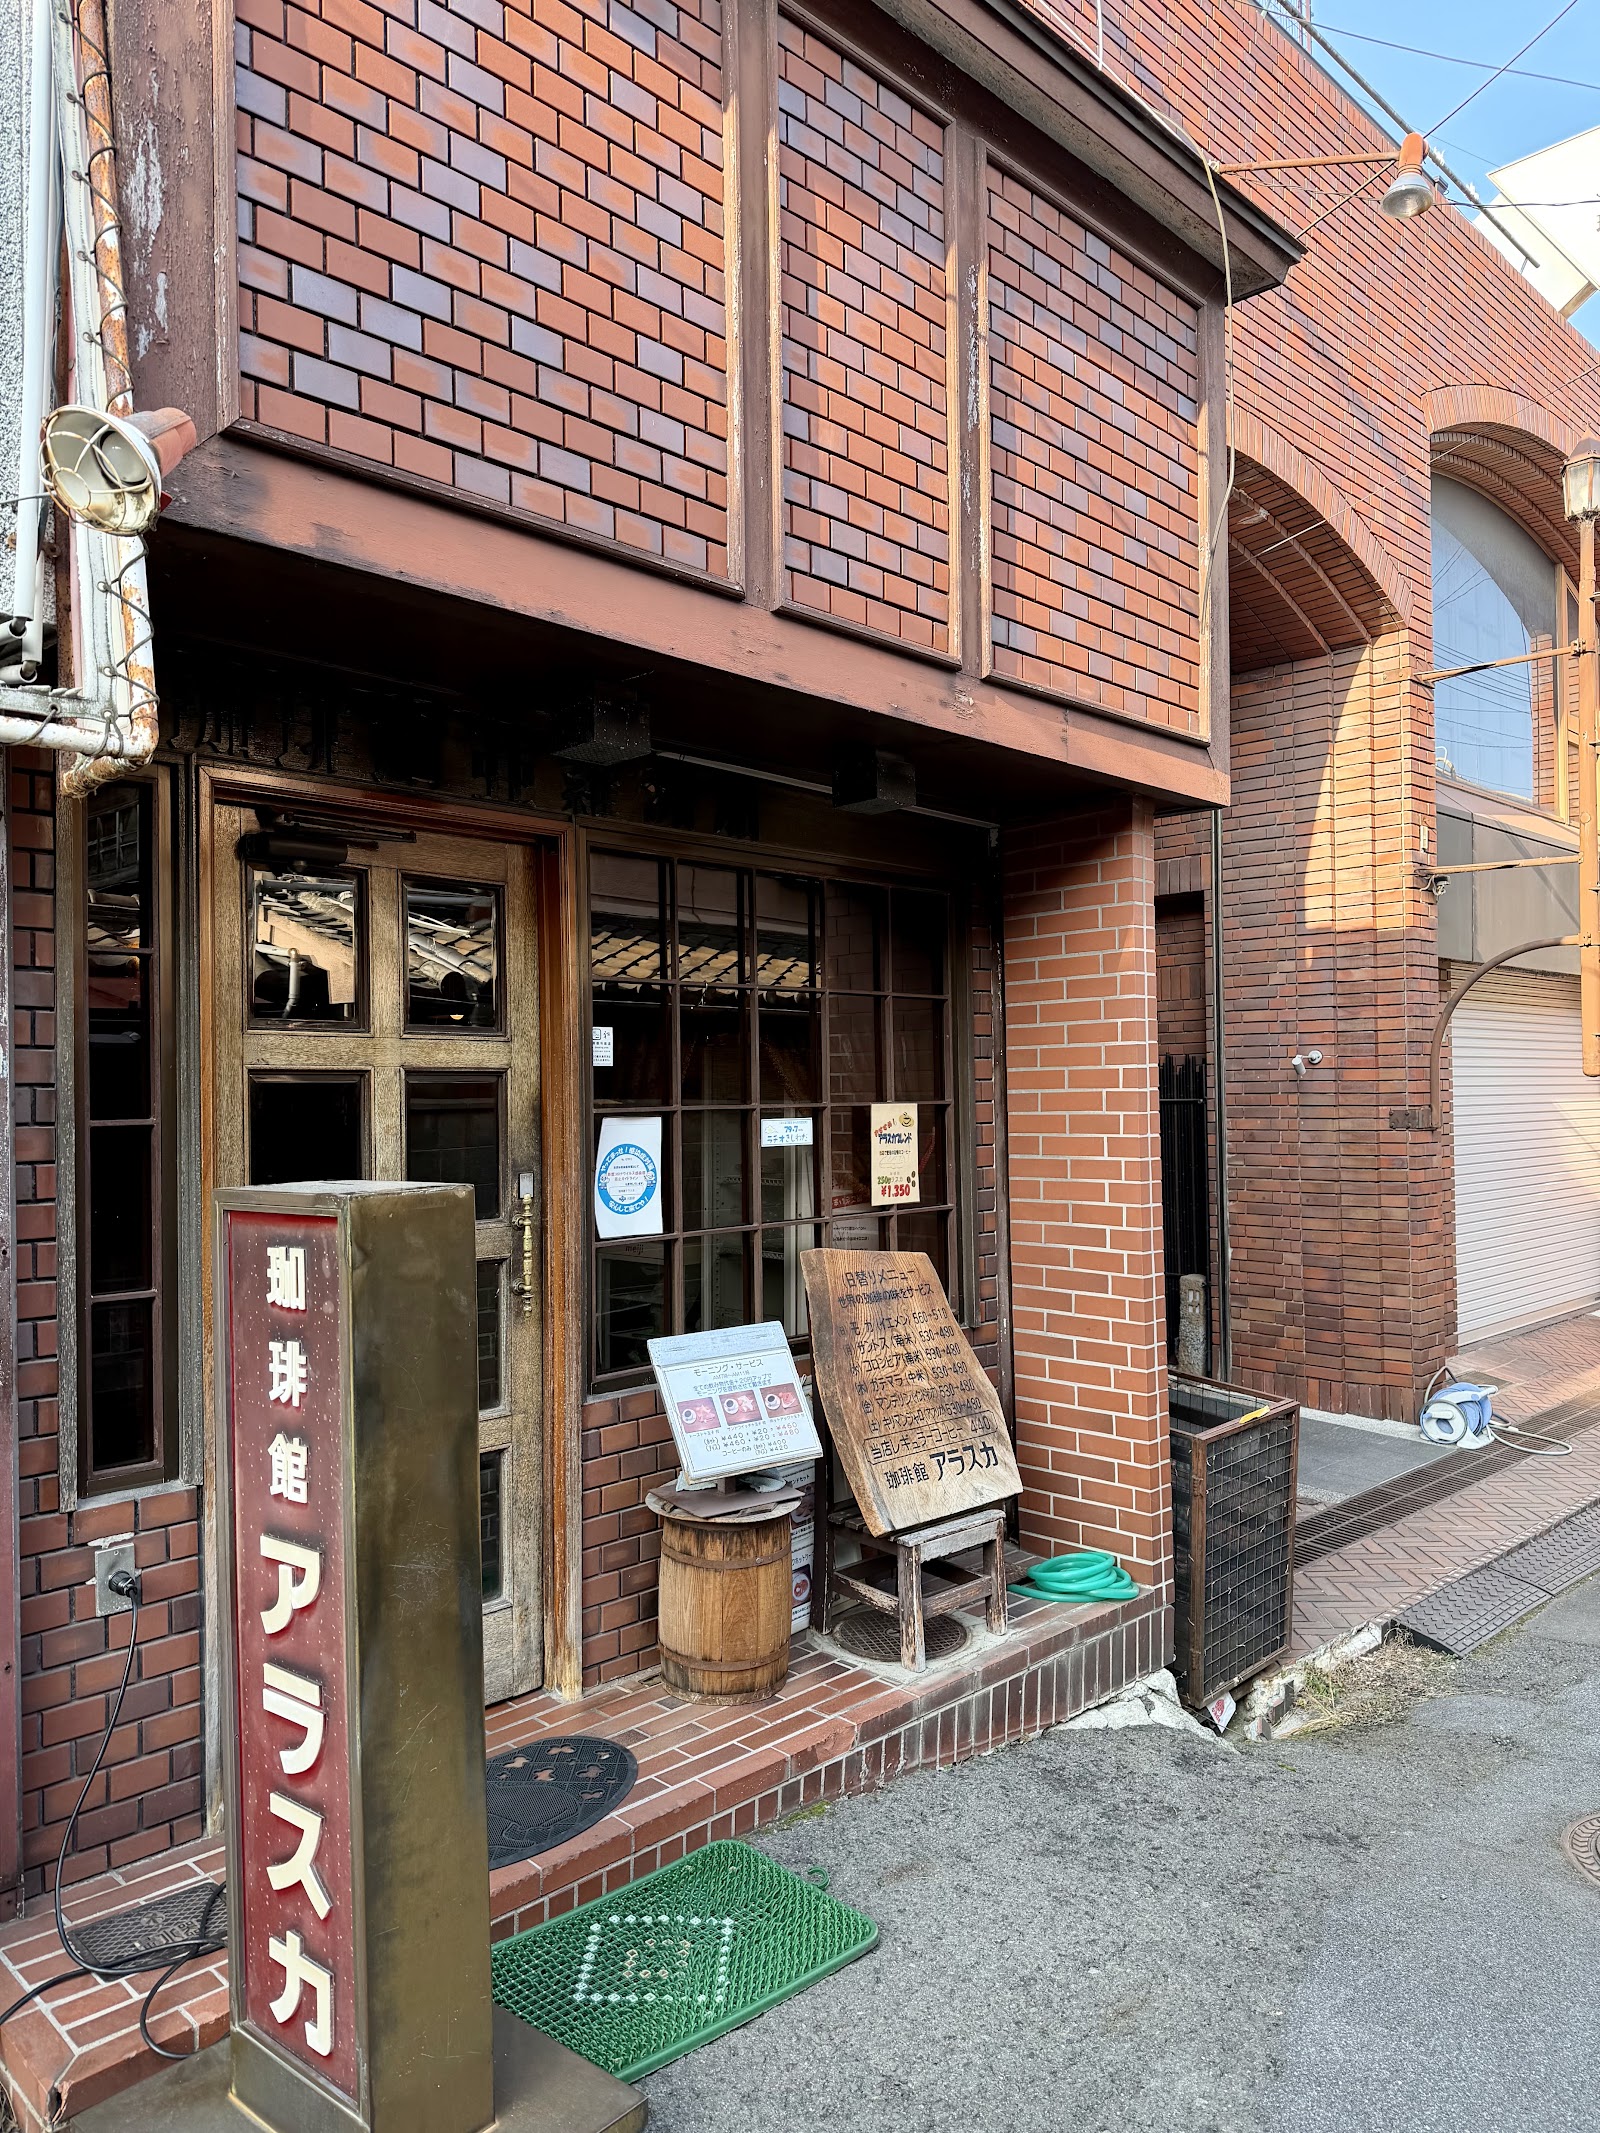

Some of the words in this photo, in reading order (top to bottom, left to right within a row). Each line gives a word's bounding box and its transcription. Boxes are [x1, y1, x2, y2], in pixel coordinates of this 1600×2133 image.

[625, 1244, 644, 1255] meiji
[837, 1283, 934, 1309] 世界の珈琲の味をサービス
[857, 1337, 890, 1354] サントス
[693, 1358, 764, 1378] モーニング・サービス
[870, 1375, 904, 1393] ガテマラ
[870, 1427, 963, 1460] 当店レギュラーコーヒー
[970, 1415, 991, 1435] 440
[883, 1462, 929, 1490] 珈琲館
[930, 1441, 999, 1482] アラスカ
[260, 1245, 334, 2057] 珈琲館アラスカ
